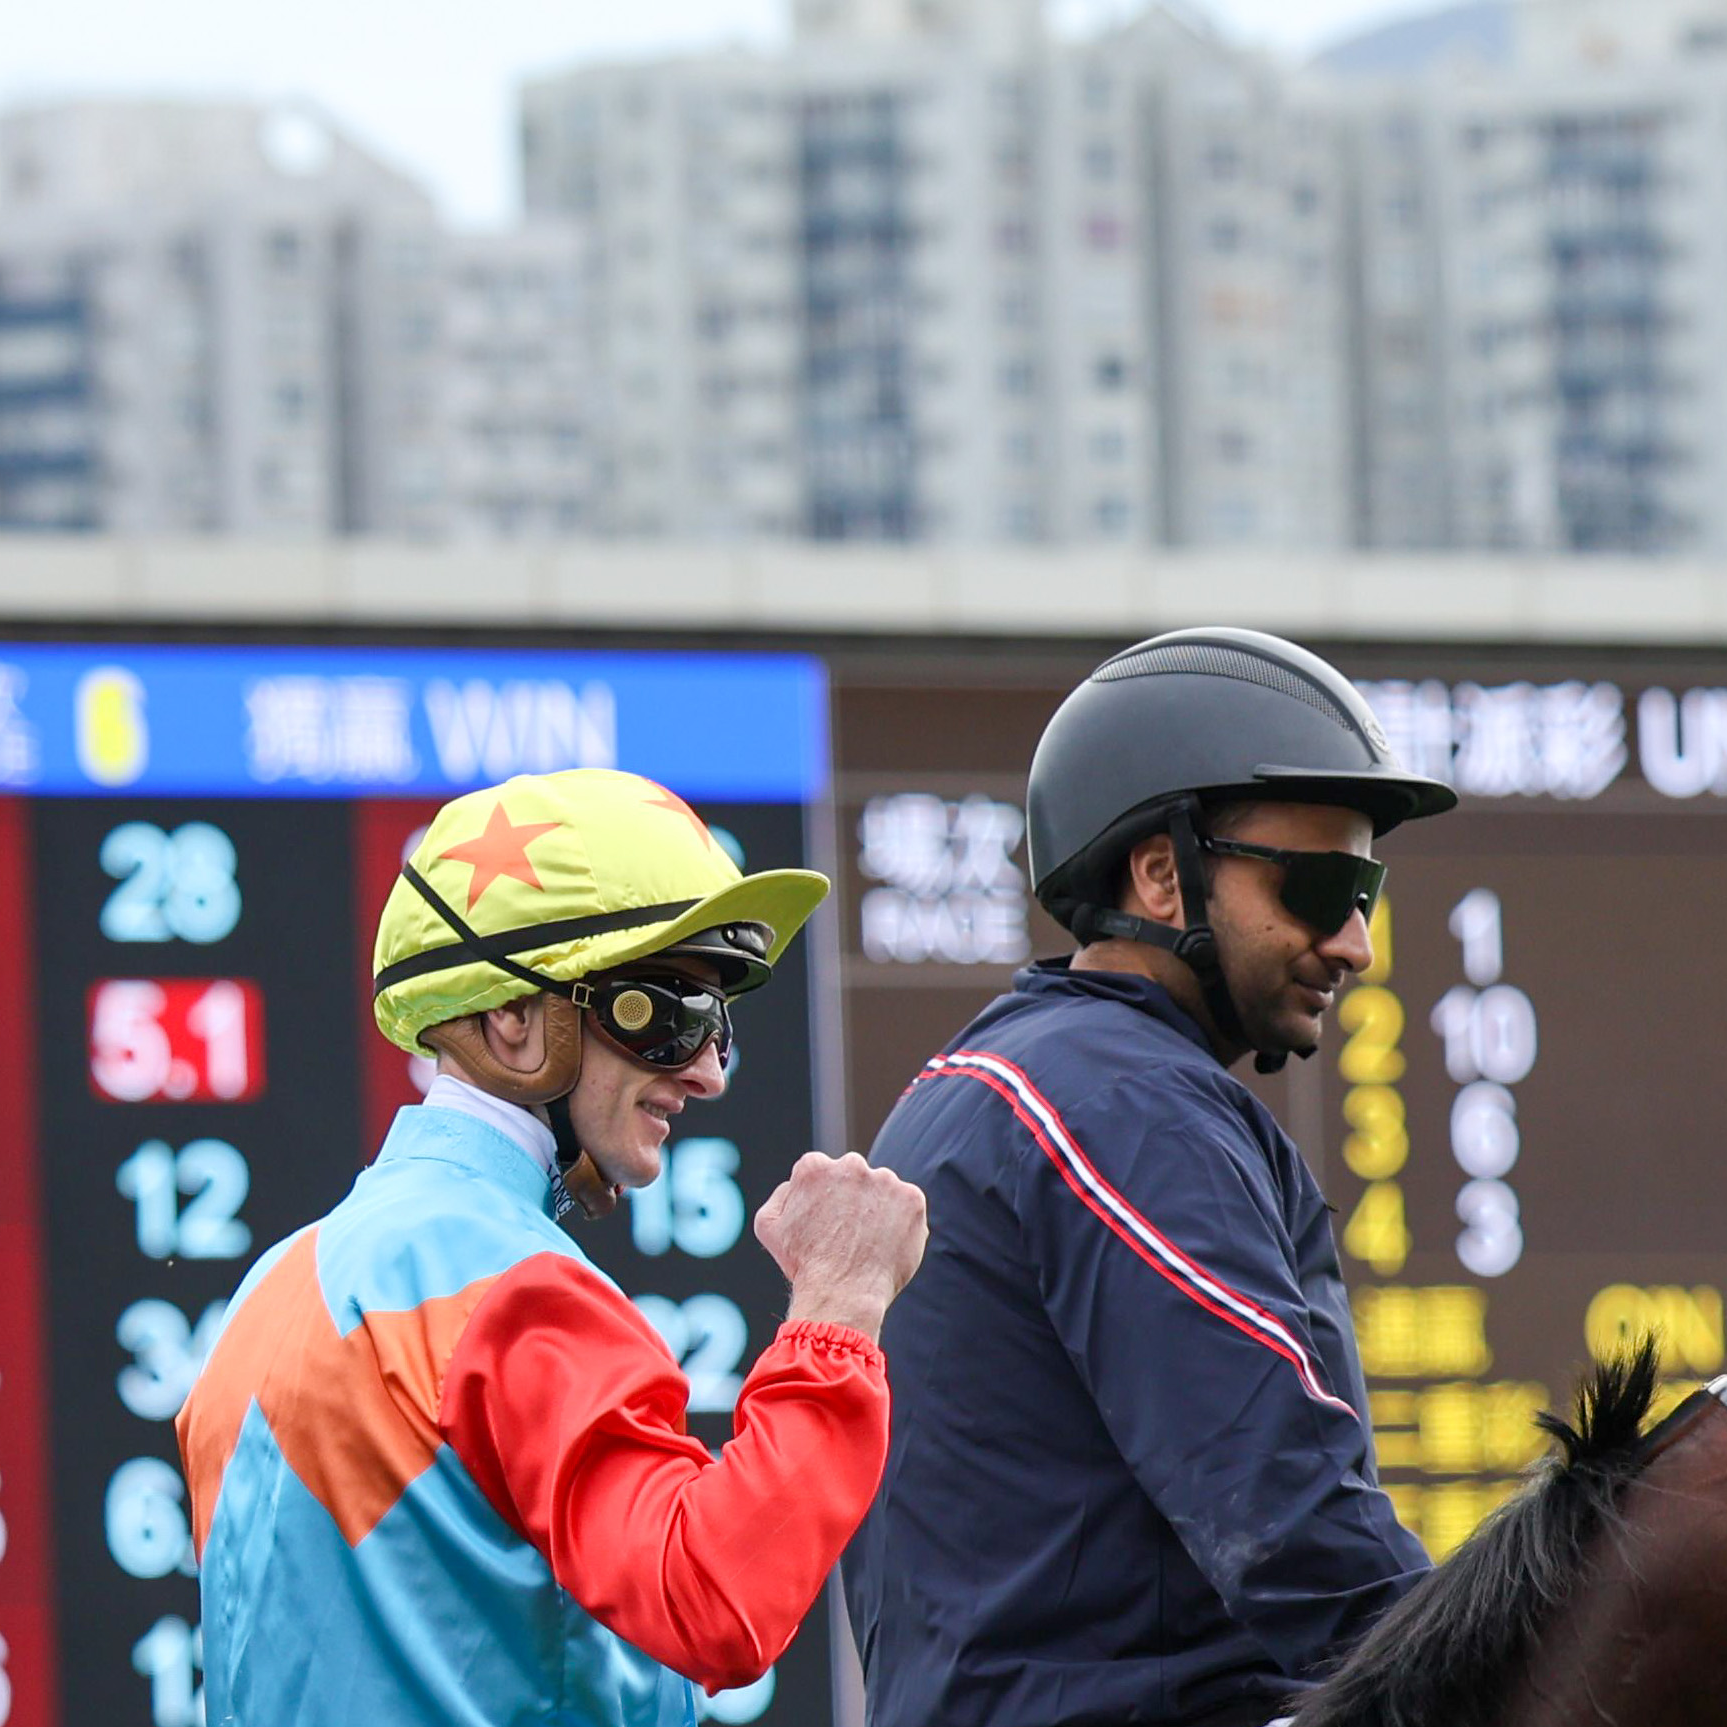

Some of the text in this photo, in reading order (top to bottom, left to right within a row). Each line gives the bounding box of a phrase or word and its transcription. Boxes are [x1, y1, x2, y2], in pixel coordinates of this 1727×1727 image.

[423, 676, 618, 785] WIN
[98, 820, 243, 944] 28
[1449, 888, 1503, 986] 1
[91, 979, 248, 1101] 5.1
[1338, 985, 1406, 1084] 2
[1430, 984, 1537, 1084] 10
[1342, 1084, 1409, 1180] 3
[1451, 1080, 1520, 1180] 6
[116, 1138, 253, 1260] 12
[626, 1137, 746, 1258] 15
[1343, 1180, 1412, 1276] 4
[1455, 1178, 1524, 1278] 3
